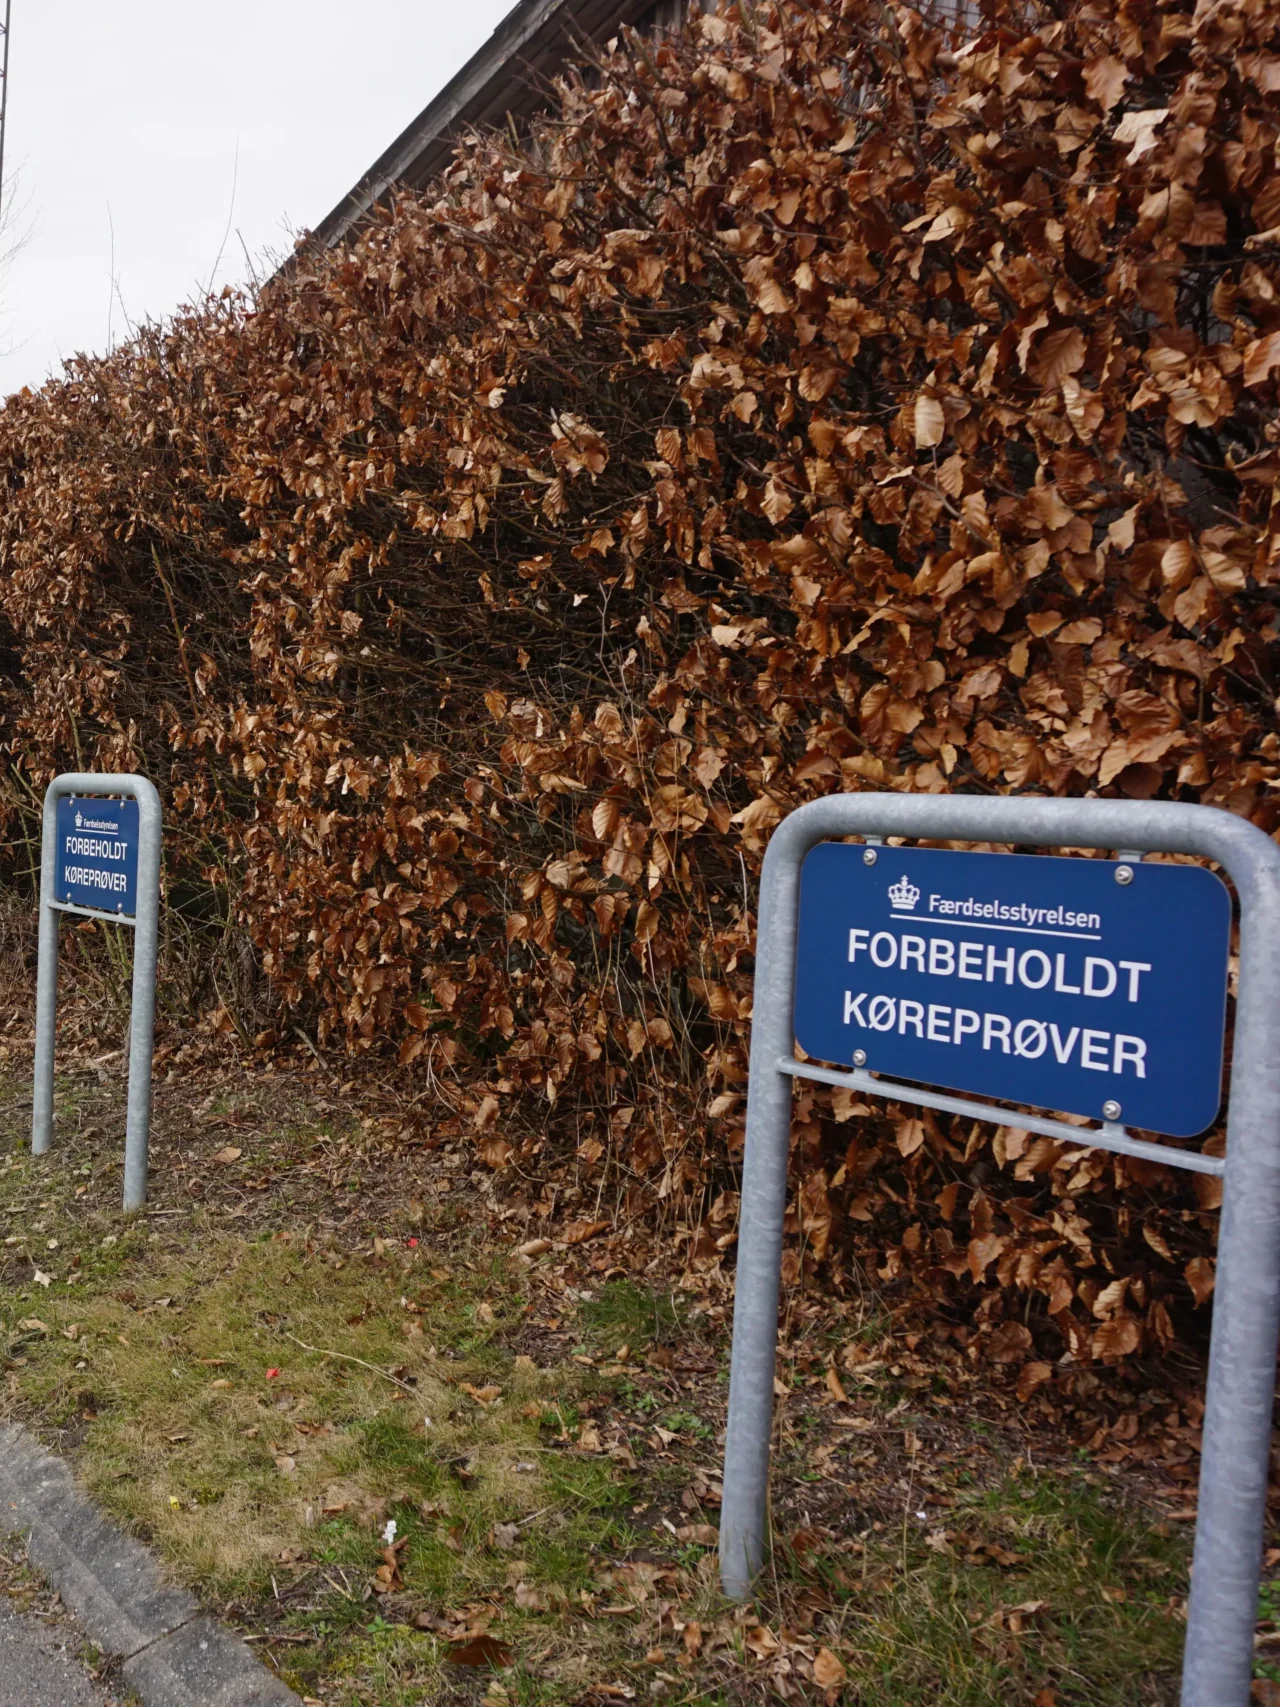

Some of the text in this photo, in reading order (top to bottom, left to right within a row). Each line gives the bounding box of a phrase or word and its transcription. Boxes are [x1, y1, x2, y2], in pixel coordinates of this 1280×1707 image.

[66, 836, 128, 861] FORBEHOLDT
[64, 865, 127, 892] KØREPRØVER
[928, 893, 1101, 930] Færdselsstyrelsen
[847, 928, 1152, 1003] FORBEHOLDT
[843, 991, 1148, 1079] KØREPRØVER
